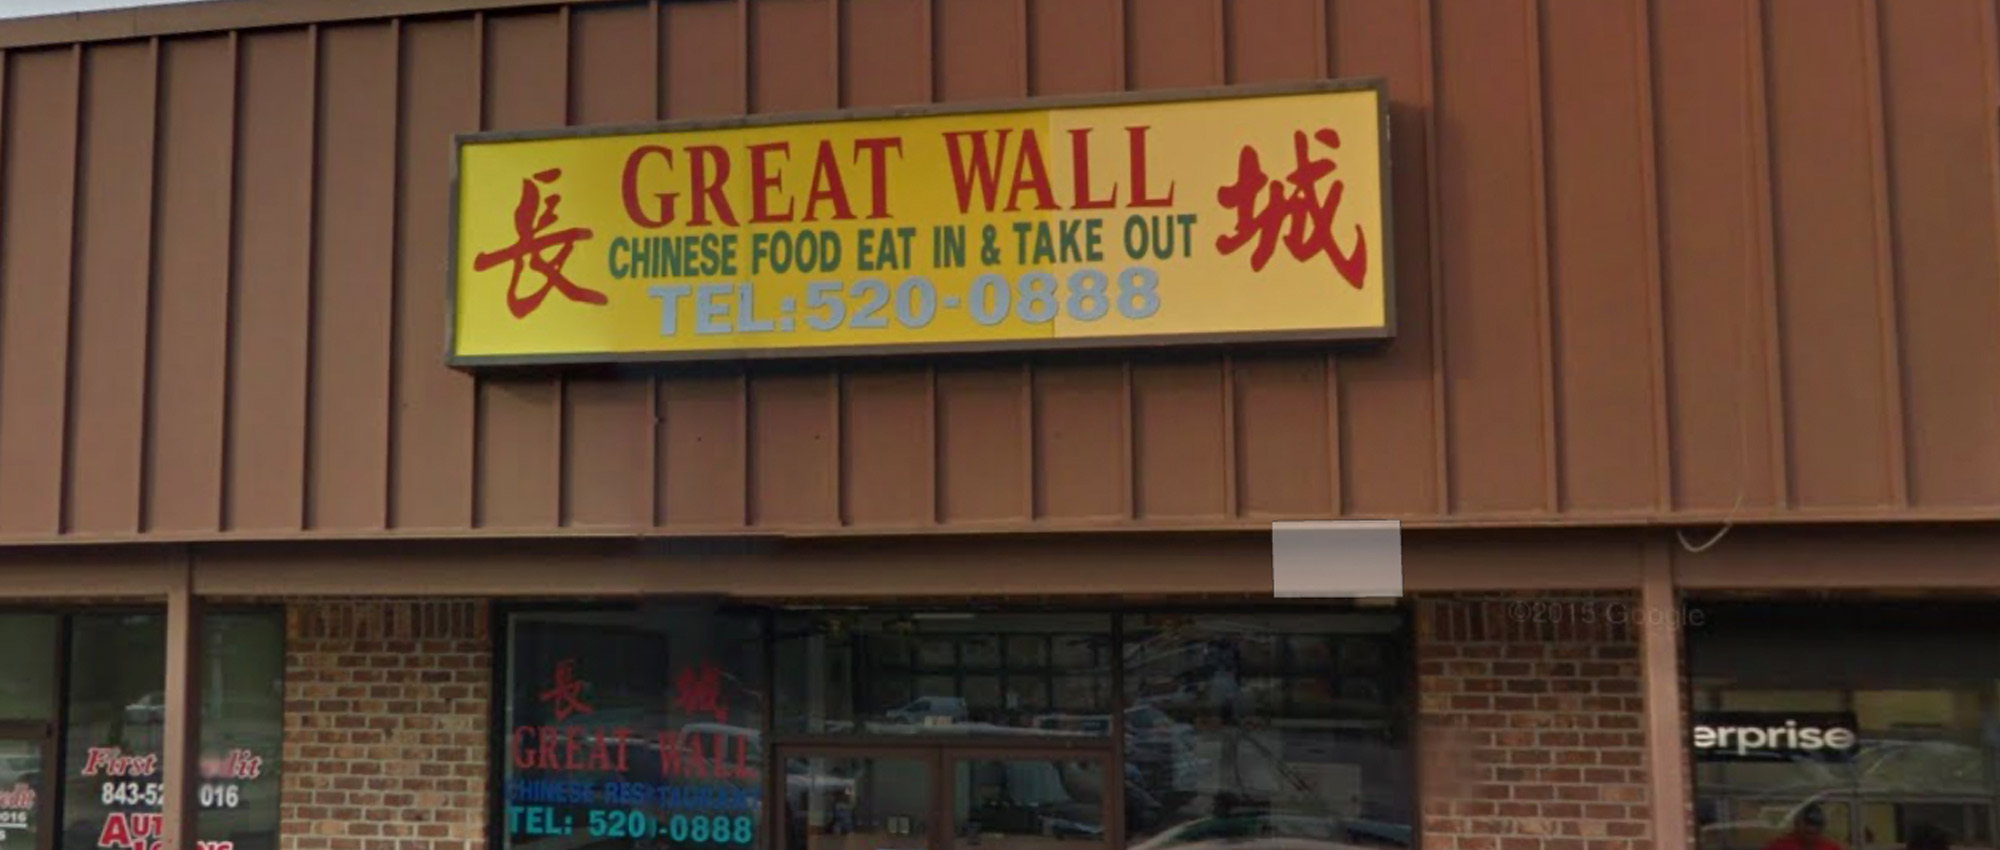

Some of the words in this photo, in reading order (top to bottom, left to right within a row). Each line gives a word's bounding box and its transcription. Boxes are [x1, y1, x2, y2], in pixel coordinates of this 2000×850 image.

[621, 137, 904, 229] GREAT
[941, 125, 1176, 215] WALL
[1216, 128, 1368, 290] 城
[473, 167, 609, 319] 長
[608, 233, 738, 280] CHINESE
[751, 229, 843, 275] FOOD
[857, 226, 917, 271] EAT
[932, 224, 966, 268] IN
[980, 222, 1001, 266] &
[1013, 217, 1104, 265] TAKE
[1123, 213, 1198, 260] OUT
[511, 723, 632, 773] GREAT
[657, 729, 759, 779] WALL
[1694, 719, 1857, 756] erprise
[81, 746, 158, 777] First
[505, 777, 598, 804] CHINESE
[97, 812, 165, 848] AUT
[506, 806, 574, 836] TEL:
